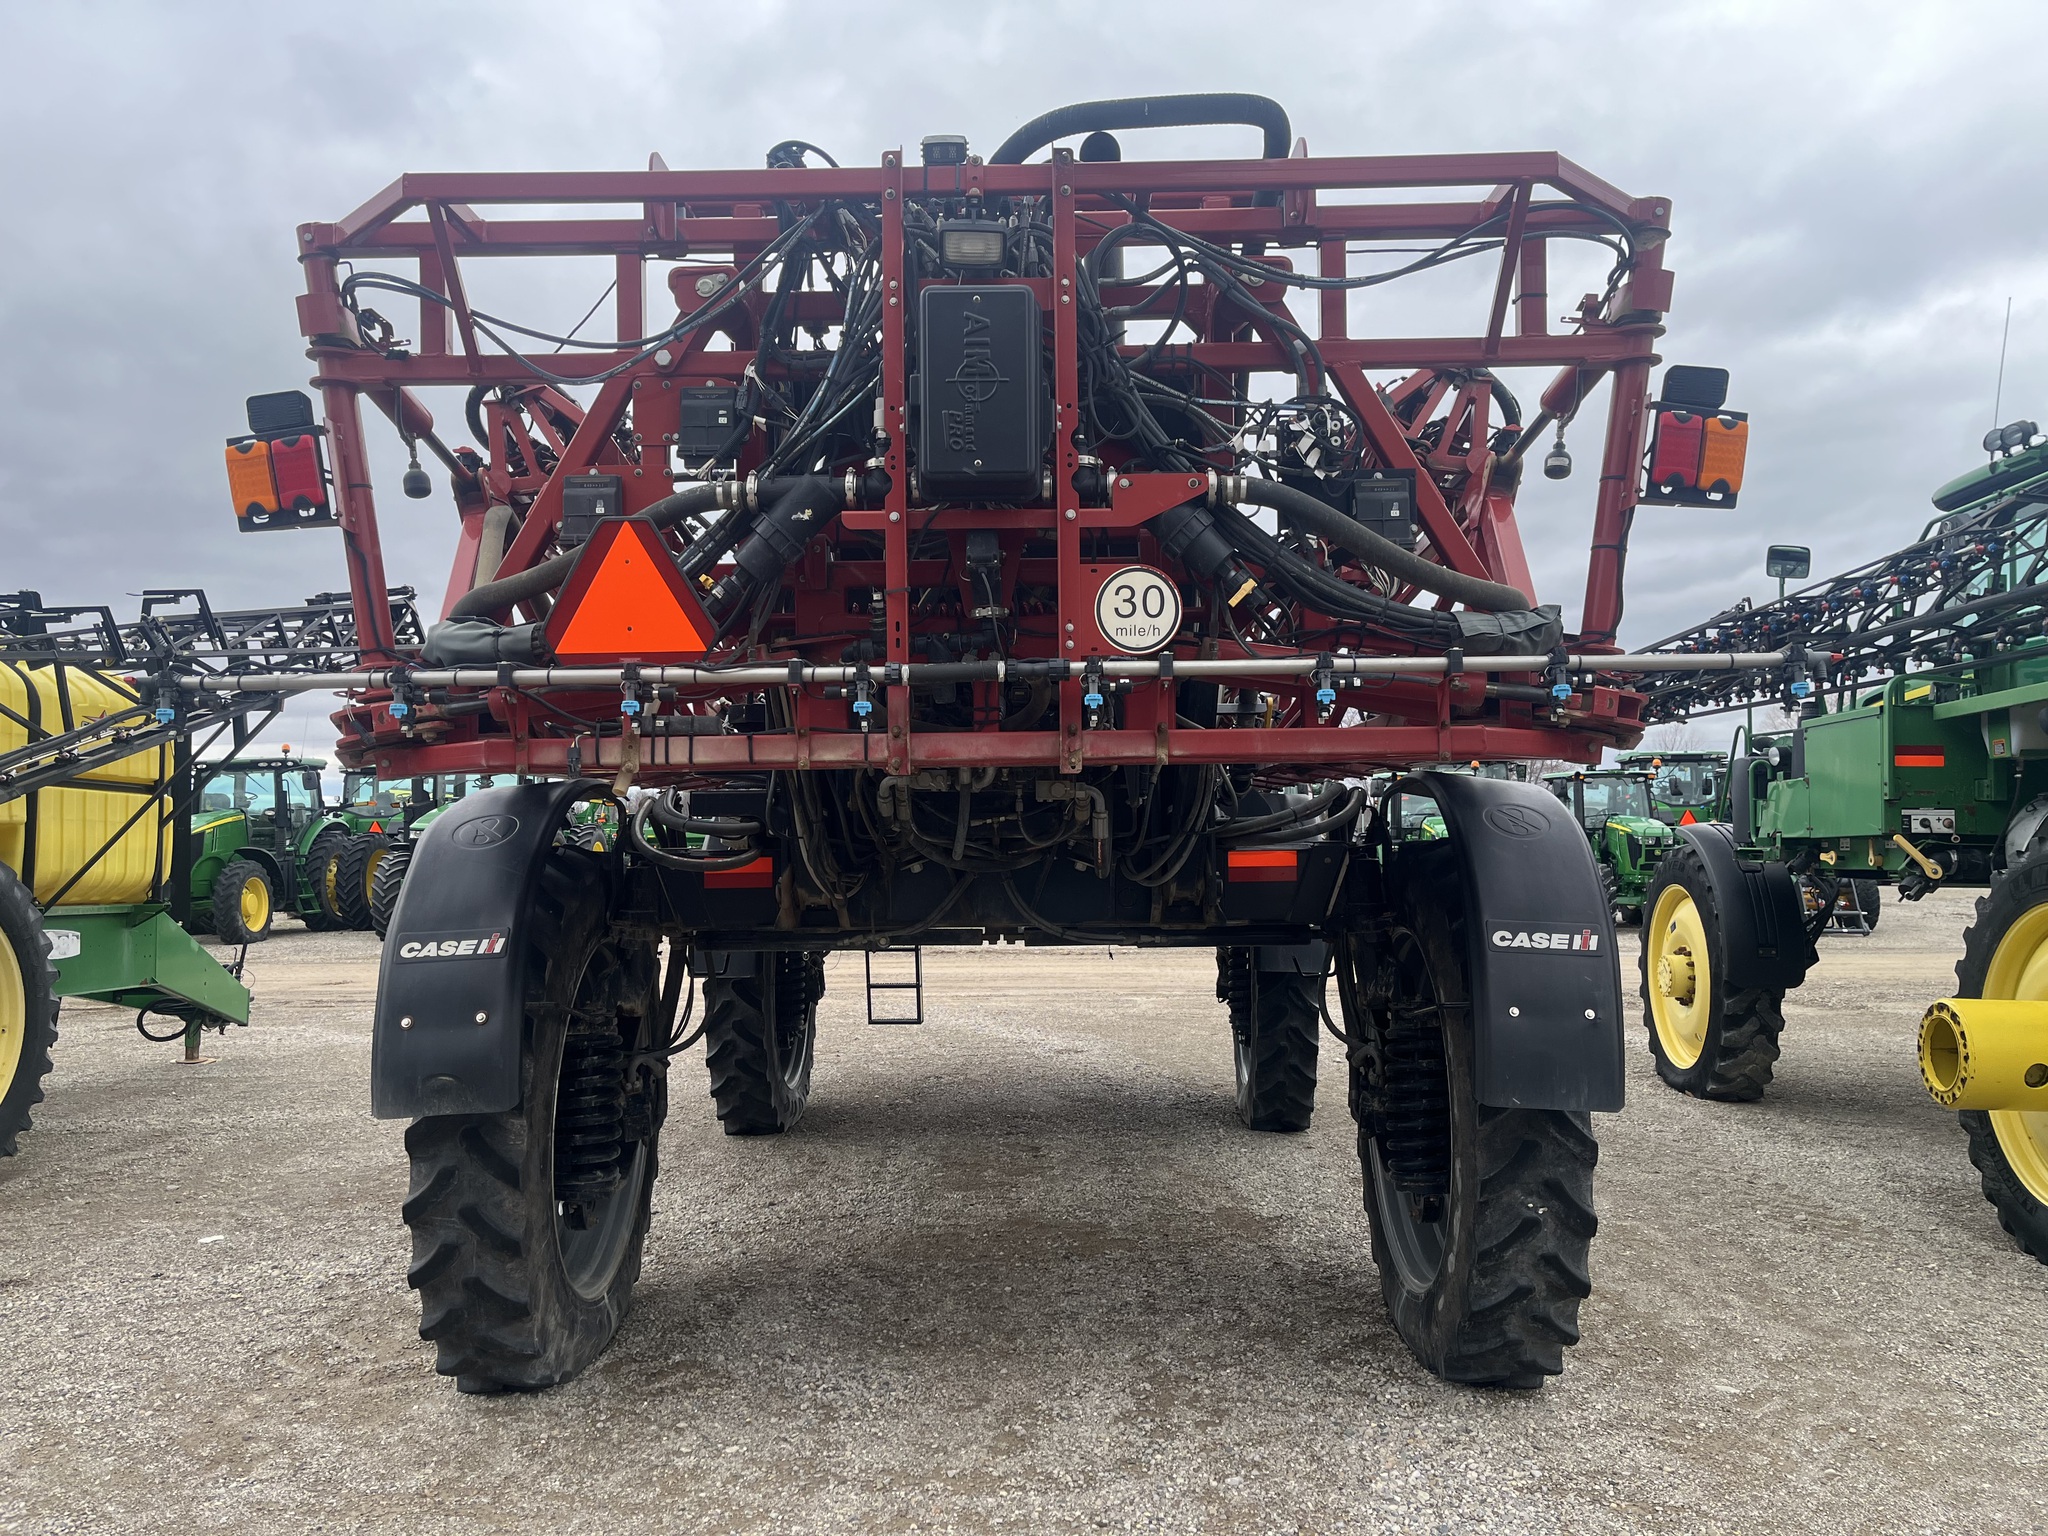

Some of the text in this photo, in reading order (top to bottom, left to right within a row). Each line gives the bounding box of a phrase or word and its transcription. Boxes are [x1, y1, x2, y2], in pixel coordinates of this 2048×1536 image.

[963, 311, 990, 376] AIM
[949, 410, 964, 450] PRO
[1114, 584, 1165, 618] 30
[1115, 624, 1161, 637] mile/h
[400, 940, 478, 958] CASE
[1492, 930, 1570, 949] CASE
